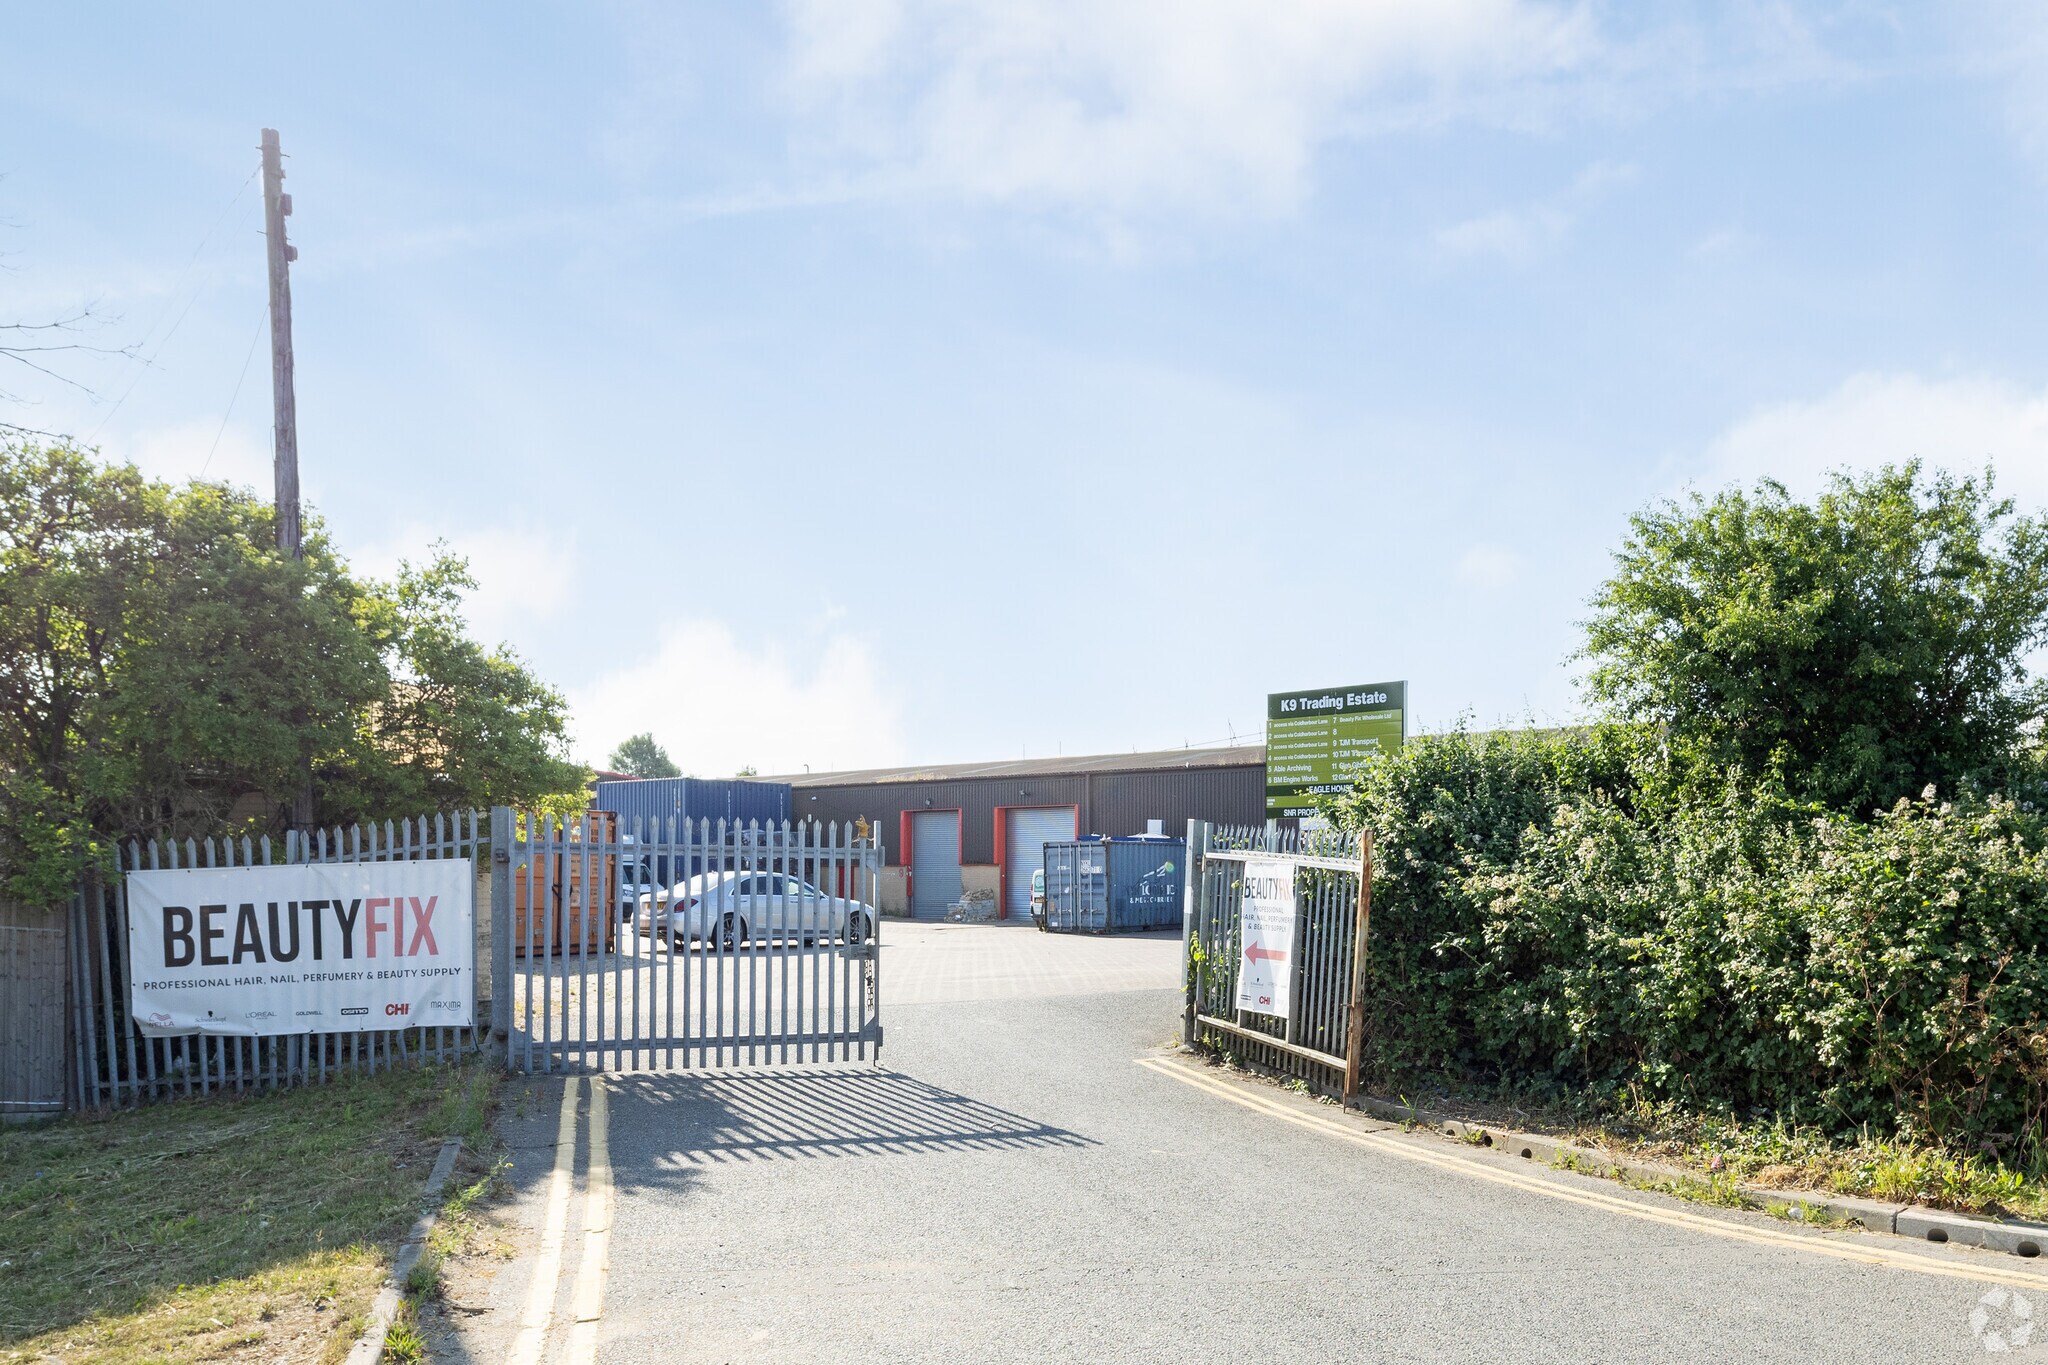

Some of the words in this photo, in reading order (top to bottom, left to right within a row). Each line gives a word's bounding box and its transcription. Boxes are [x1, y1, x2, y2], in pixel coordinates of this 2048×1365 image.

[1281, 699, 1297, 712] K9
[1300, 695, 1344, 710] Trading
[1346, 691, 1387, 706] Estate
[1351, 737, 1378, 746] Transport
[1287, 764, 1312, 772] Archiving
[1283, 776, 1300, 784] Engine
[1244, 877, 1291, 901] BEAUTYFIX
[163, 896, 439, 967] BEAUTYFIX
[144, 978, 230, 990] PROFESSIONAL
[235, 976, 266, 986] HAIR,
[271, 975, 299, 984] NAIL,
[304, 972, 364, 982] PERFUMERY
[378, 970, 417, 979] BEAUTY
[421, 968, 461, 977] SUPPLY
[1259, 996, 1271, 1005] CHI
[385, 1004, 409, 1016] CHI
